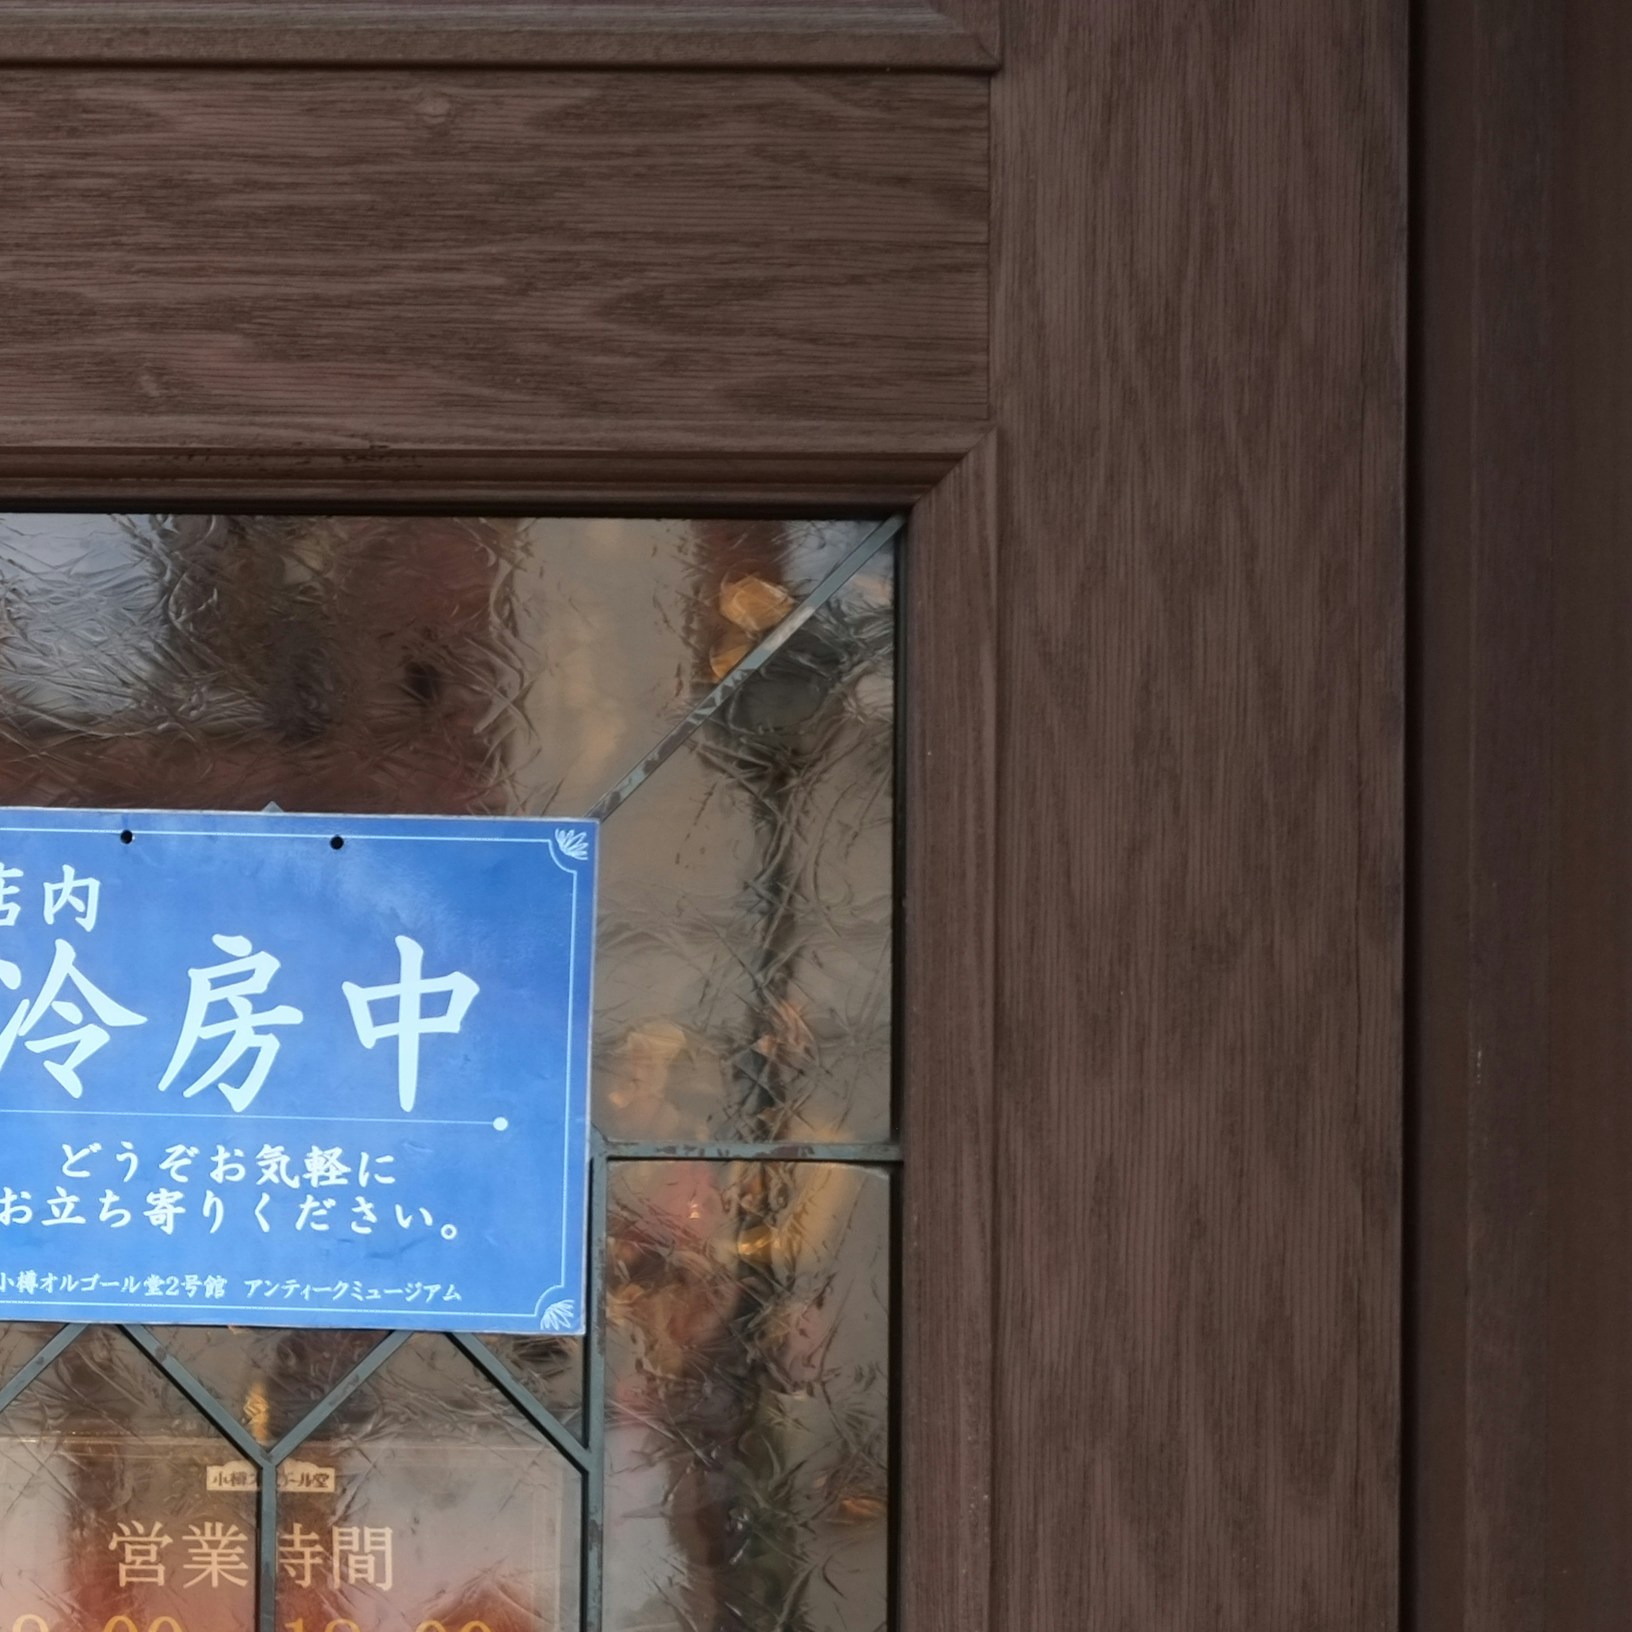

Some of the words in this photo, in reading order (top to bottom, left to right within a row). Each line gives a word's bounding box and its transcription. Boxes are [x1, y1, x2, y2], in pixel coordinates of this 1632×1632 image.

[59, 1140, 397, 1188] どうぞお気軽に
[243, 1277, 463, 1303] アンティークミュージアム
